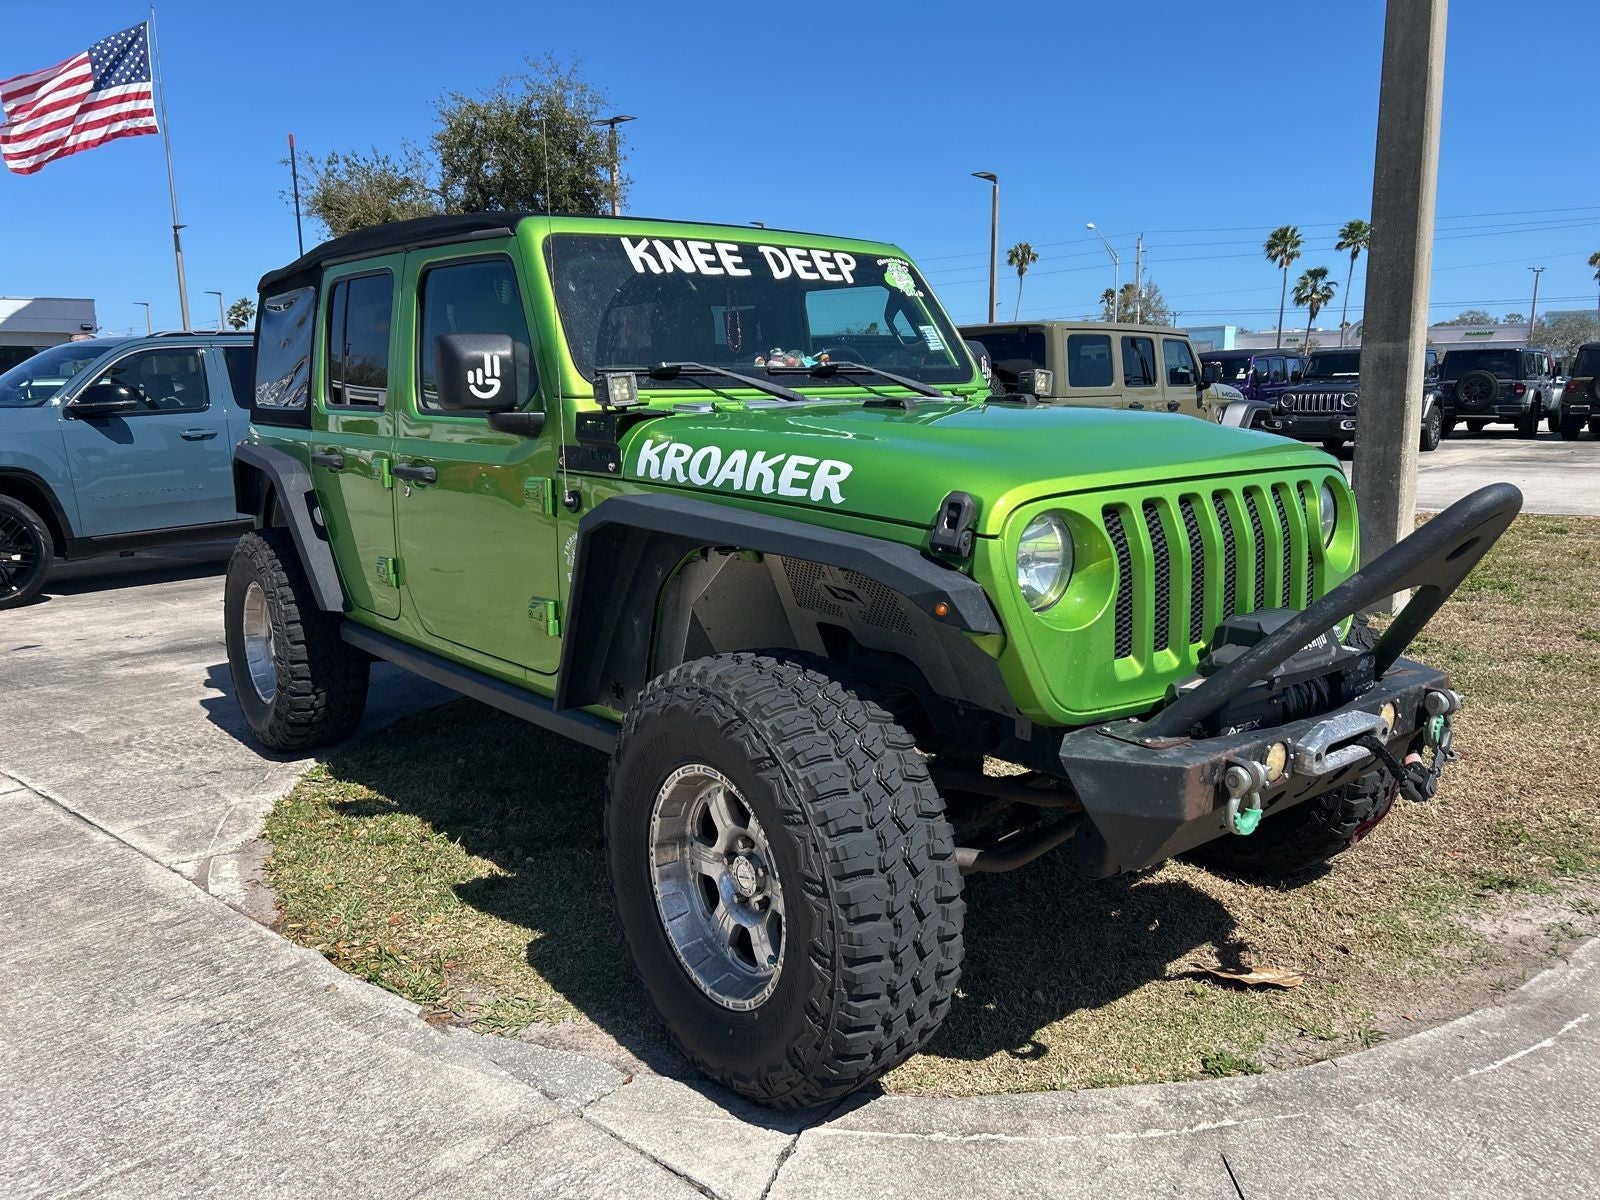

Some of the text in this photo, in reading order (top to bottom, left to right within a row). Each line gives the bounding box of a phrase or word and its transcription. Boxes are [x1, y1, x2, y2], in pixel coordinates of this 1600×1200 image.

[620, 236, 857, 284] KNEE DEEP
[636, 438, 854, 505] KROAKER
[1226, 718, 1261, 736] APEX
